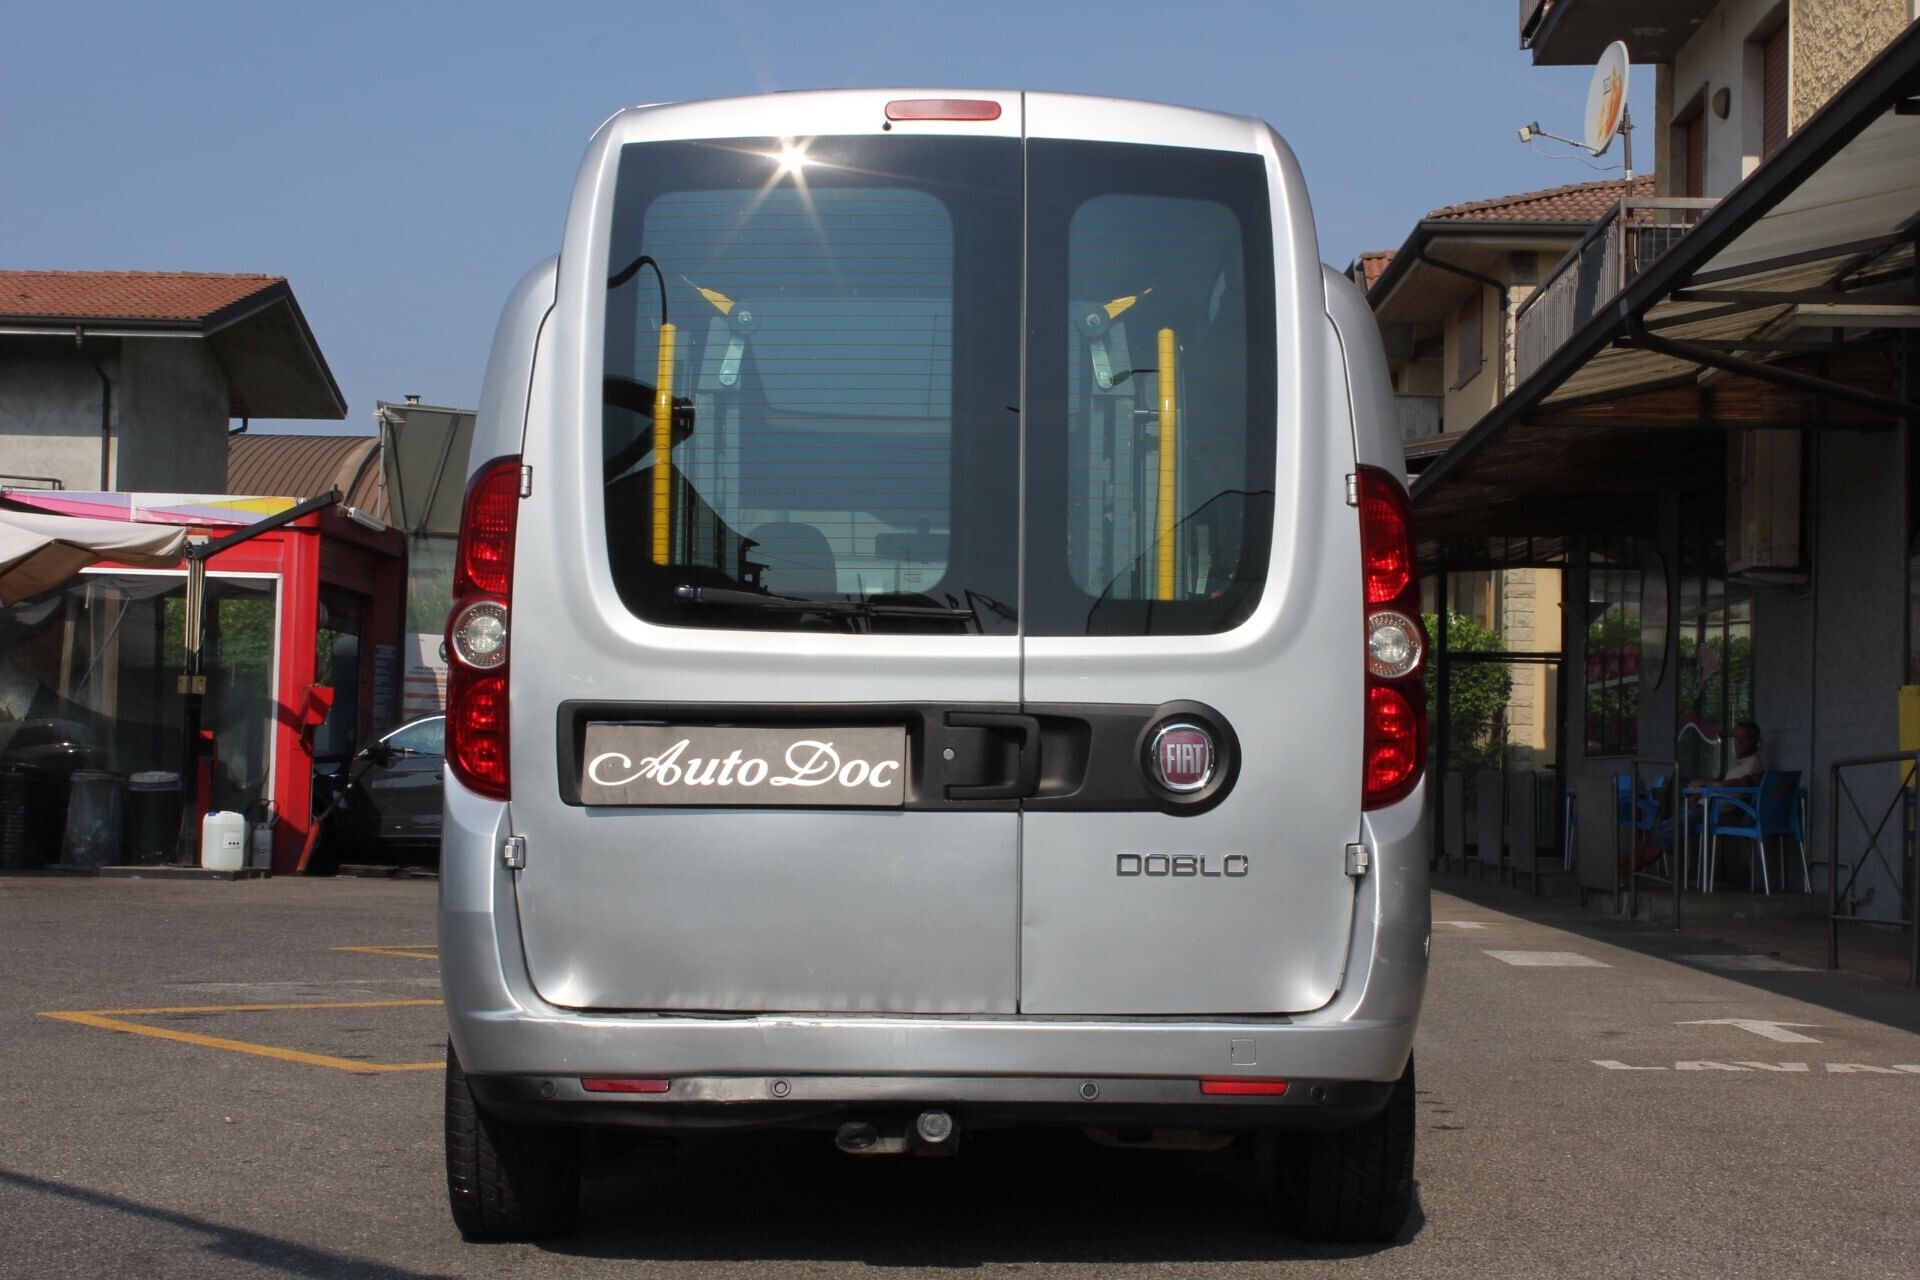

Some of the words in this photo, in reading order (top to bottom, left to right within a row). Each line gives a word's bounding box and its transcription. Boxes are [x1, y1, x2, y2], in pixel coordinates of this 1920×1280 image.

[588, 738, 768, 787] Auto
[769, 739, 900, 789] Doc
[1166, 743, 1204, 774] FIAT
[1116, 853, 1249, 878] DOBLO
